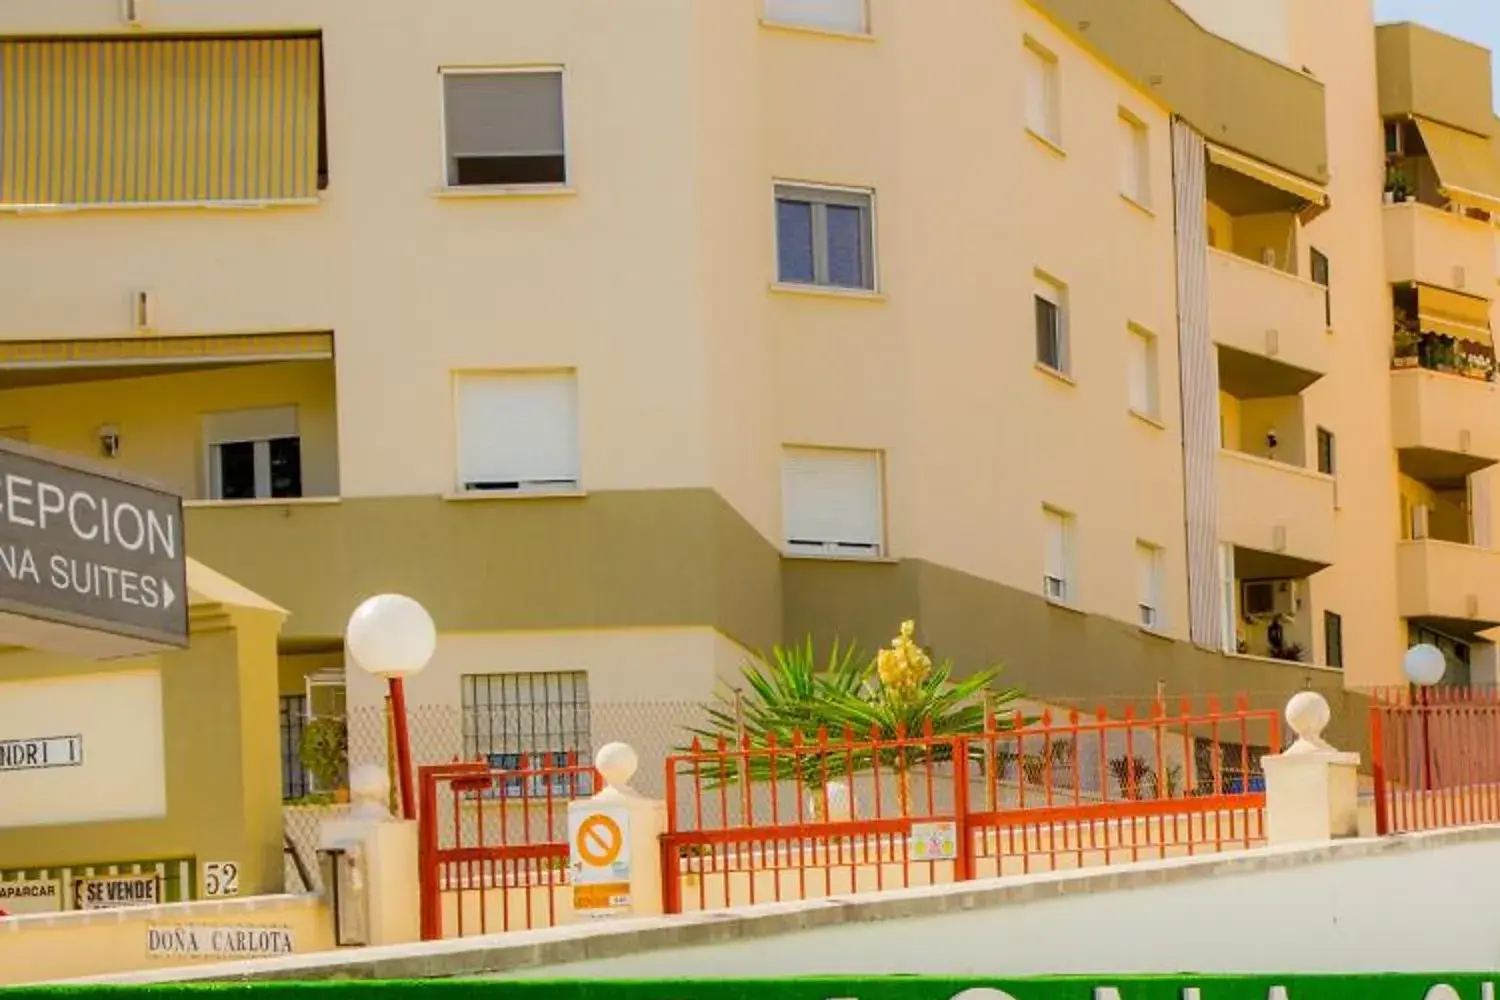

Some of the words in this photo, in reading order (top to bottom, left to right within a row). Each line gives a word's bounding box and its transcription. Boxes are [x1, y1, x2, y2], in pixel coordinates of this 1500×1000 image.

[0, 474, 175, 559] EPCION
[50, 555, 159, 608] SUITES
[87, 882, 104, 901] SE
[106, 880, 153, 900] VENDE
[207, 863, 238, 895] 52
[149, 928, 199, 951] DOÑA
[211, 930, 293, 952] CARLOTA
